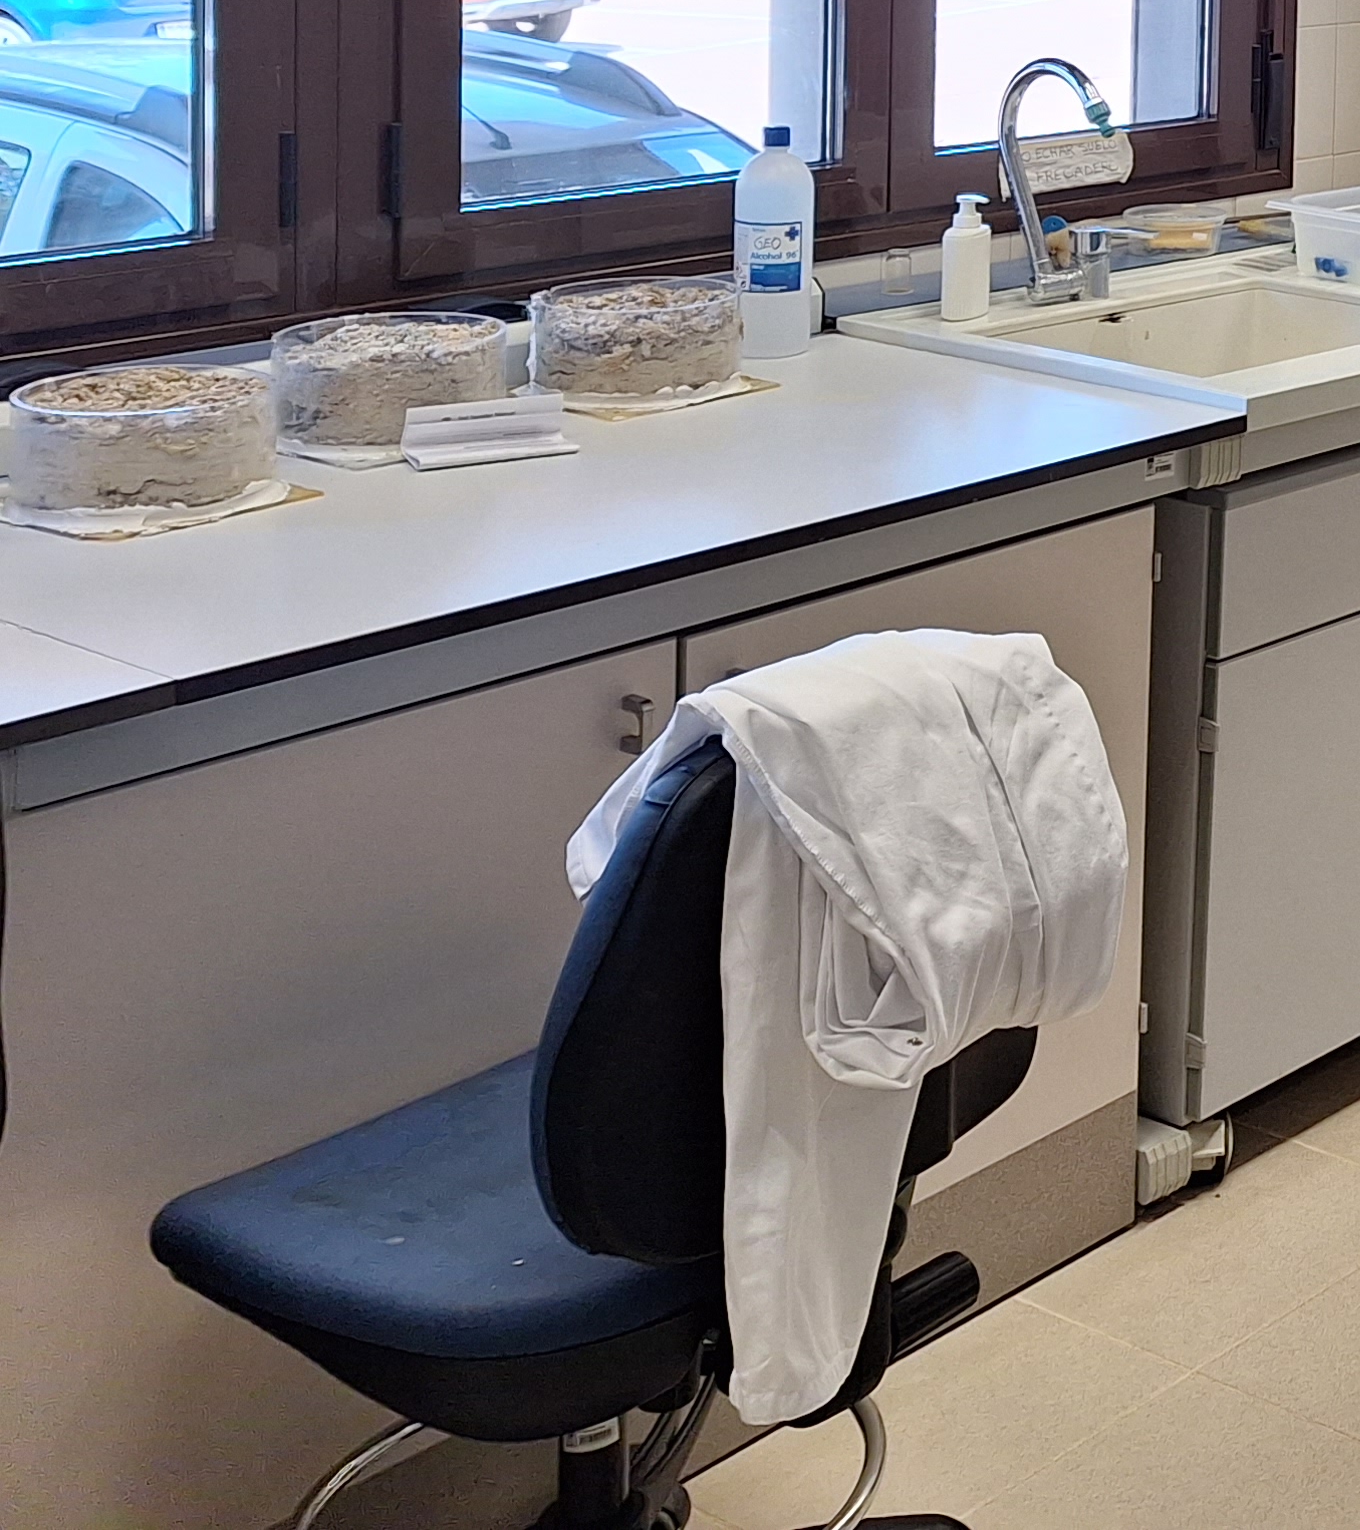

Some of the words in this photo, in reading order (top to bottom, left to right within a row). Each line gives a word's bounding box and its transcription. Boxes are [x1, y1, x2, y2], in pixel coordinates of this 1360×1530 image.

[1035, 143, 1076, 160] ECHAR
[1079, 139, 1118, 153] SUELO
[754, 236, 782, 250] GEO
[750, 251, 783, 260] Alcohol
